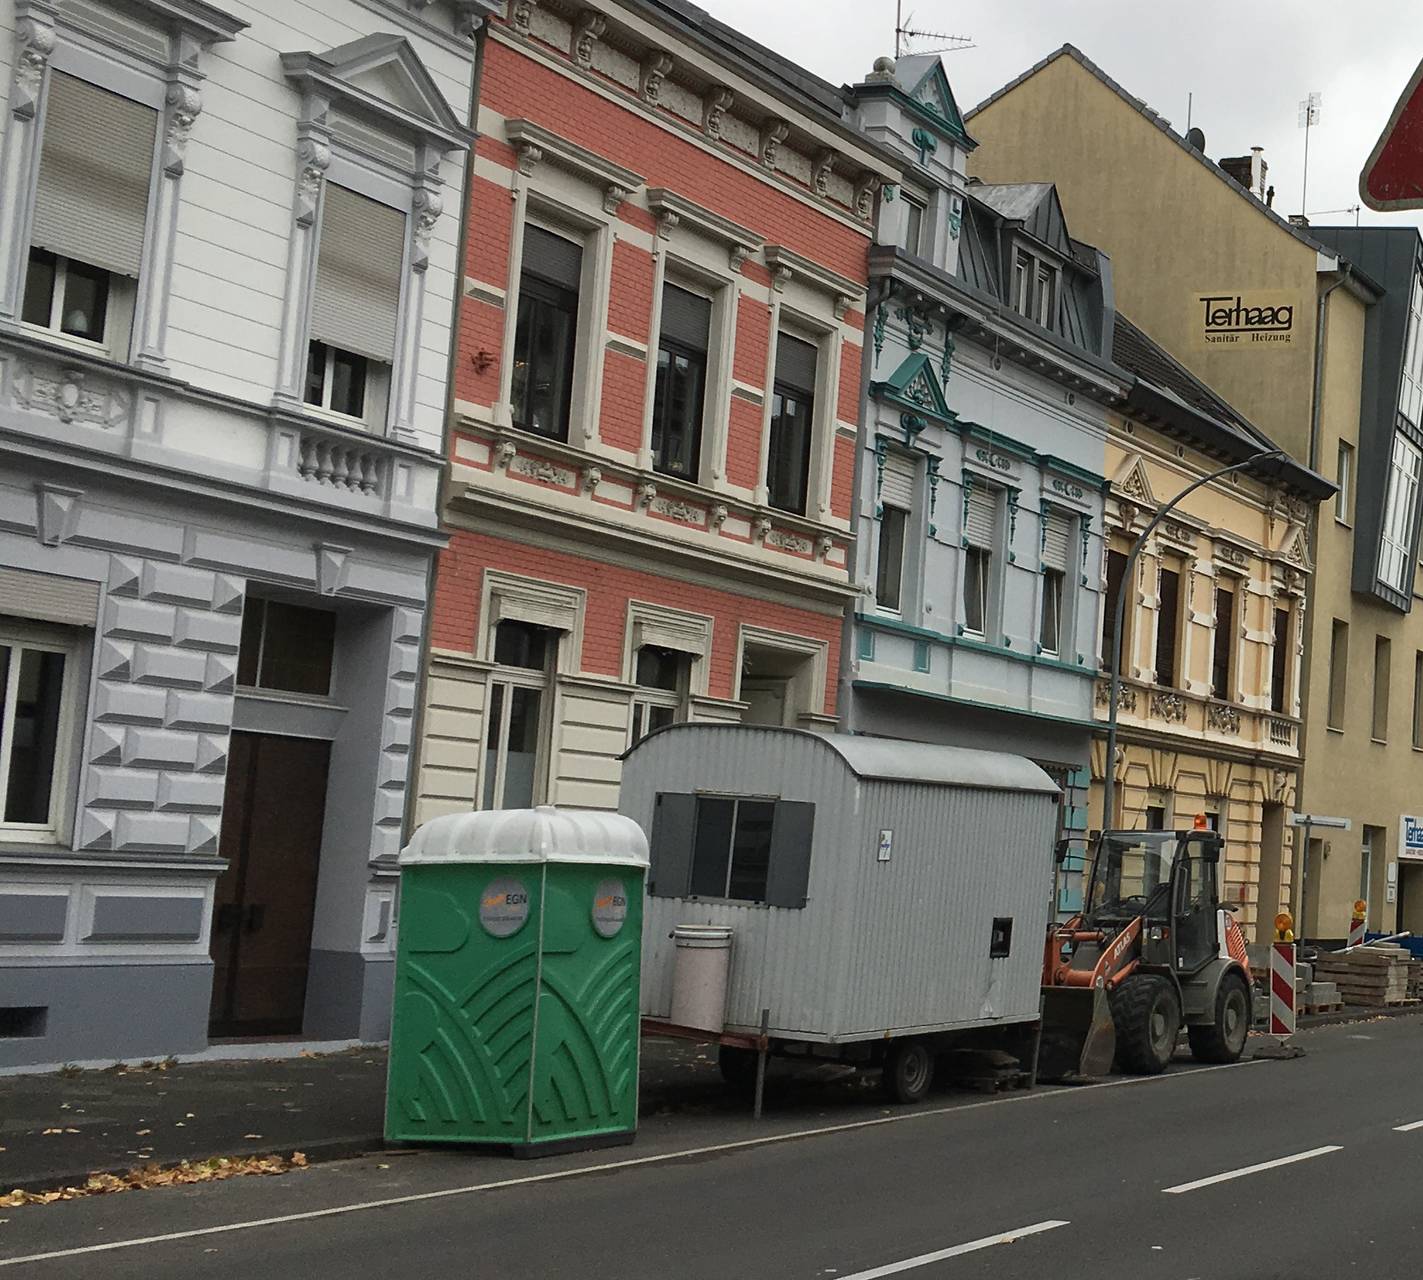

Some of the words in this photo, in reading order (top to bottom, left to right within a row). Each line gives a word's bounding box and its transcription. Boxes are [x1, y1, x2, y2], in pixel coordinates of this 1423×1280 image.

[1200, 296, 1293, 331] Terhaag
[1205, 334, 1239, 343] Sanitär
[1251, 333, 1291, 343] Heizung
[506, 894, 527, 905] EGN
[1113, 932, 1131, 960] ATLAS
